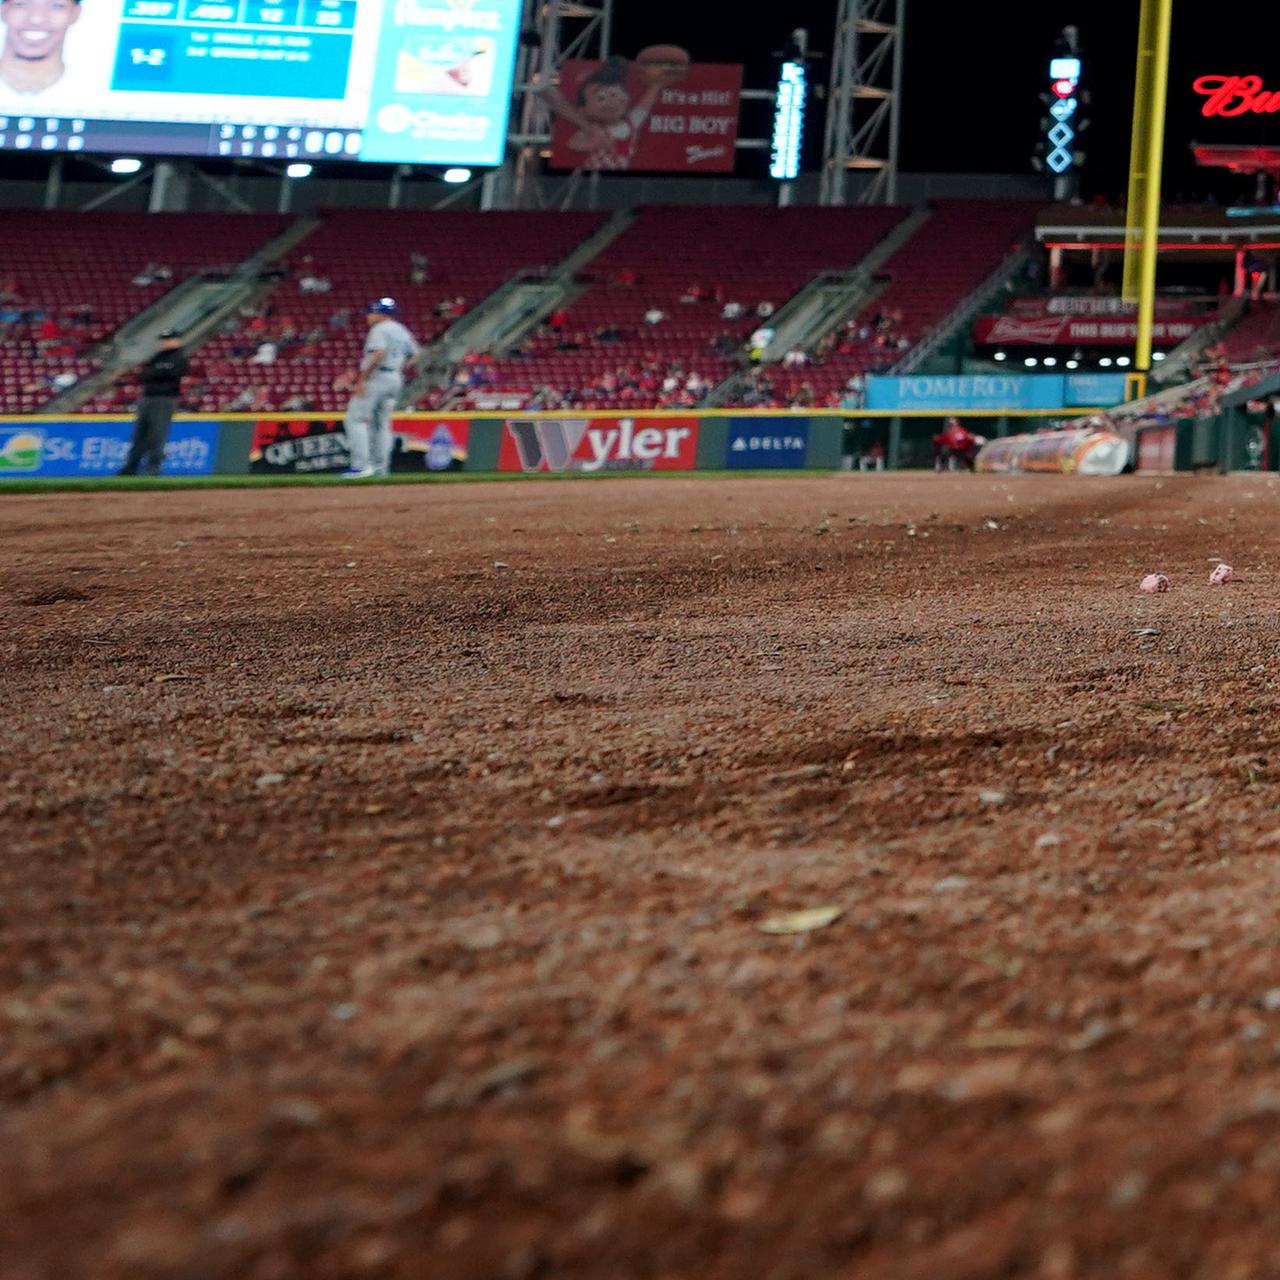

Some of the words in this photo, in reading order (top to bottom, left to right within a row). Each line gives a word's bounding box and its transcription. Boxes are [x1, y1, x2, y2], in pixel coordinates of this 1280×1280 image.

[649, 115, 684, 134] BIG
[688, 115, 731, 135] BOY
[898, 376, 1024, 399] POMEROY
[505, 419, 690, 472] Wyler
[749, 436, 804, 451] DELTA
